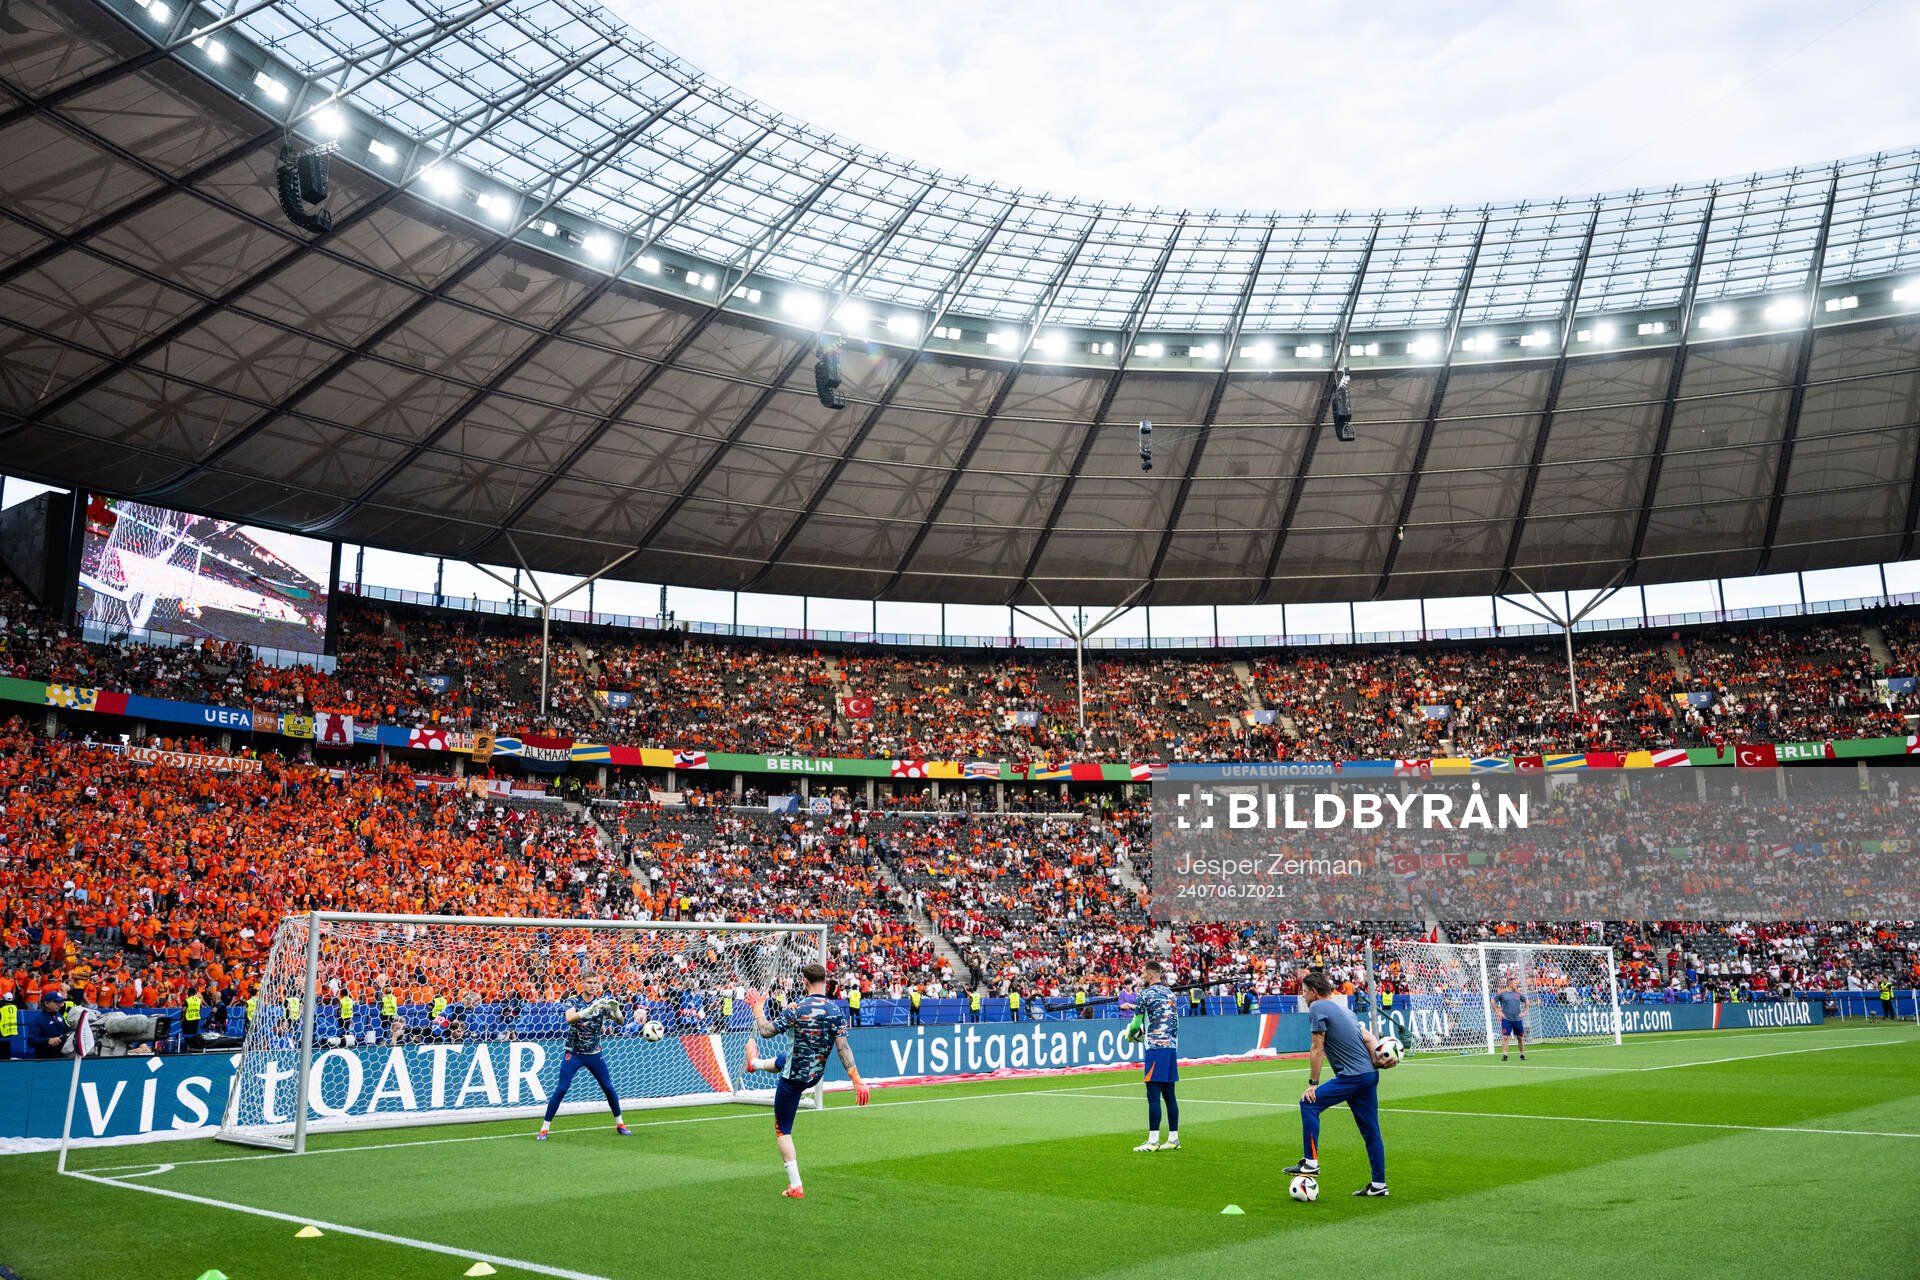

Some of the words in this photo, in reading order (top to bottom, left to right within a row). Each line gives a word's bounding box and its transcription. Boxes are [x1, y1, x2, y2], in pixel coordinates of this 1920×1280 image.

[431, 677, 445, 687] 38
[613, 695, 627, 703] 39
[204, 709, 250, 727] UEFA
[525, 745, 571, 760] ALKMAAR
[1774, 744, 1826, 758] ERLI
[128, 746, 263, 774] KLOOSTERZANDE
[767, 758, 834, 772] BERLIN
[1747, 1001, 1811, 1027] visitQATAR
[890, 1023, 1147, 1075] visitqatar.co
[80, 1040, 548, 1137] visitQATAR
